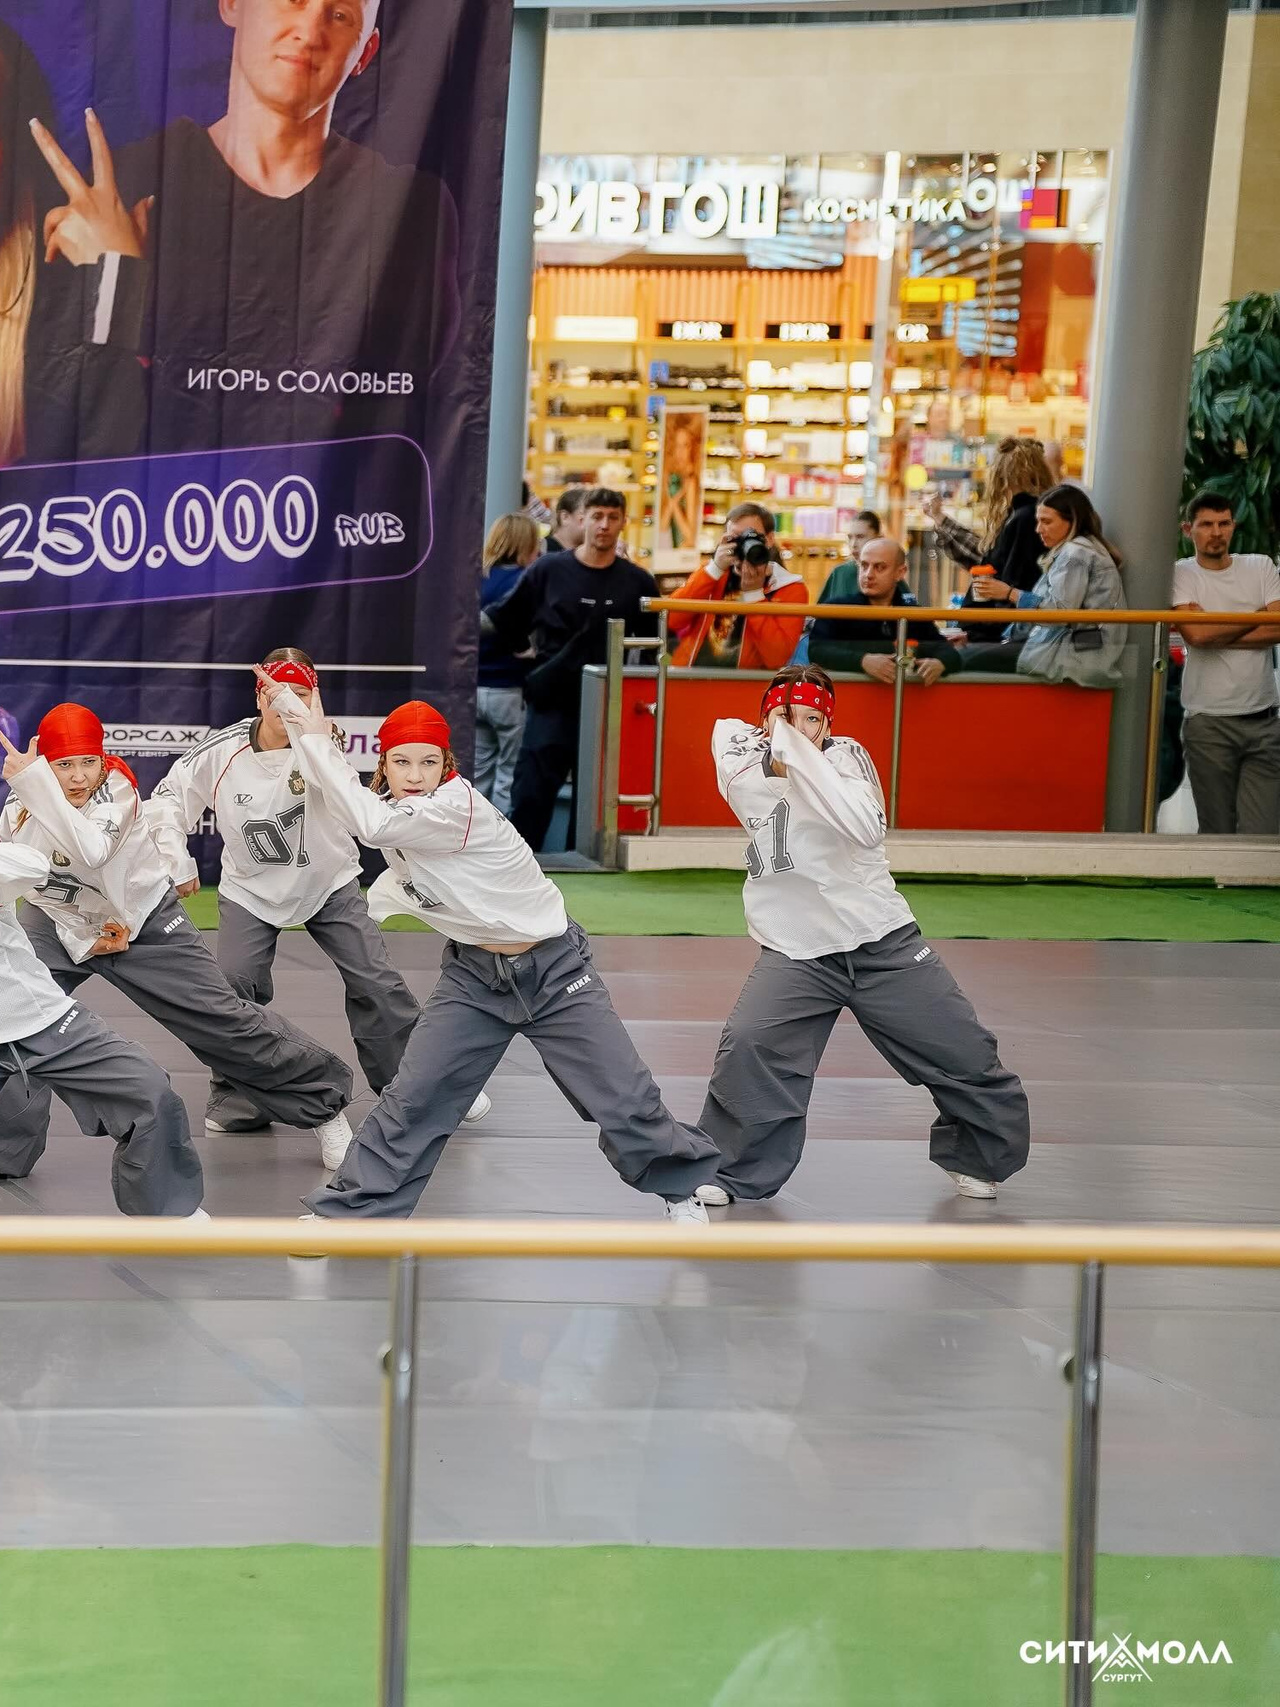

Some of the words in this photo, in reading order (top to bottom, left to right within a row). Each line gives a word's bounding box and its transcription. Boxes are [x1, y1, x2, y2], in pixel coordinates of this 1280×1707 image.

[803, 197, 967, 223] КОСМЕТИКА
[187, 368, 270, 392] ИГОРЬ
[277, 370, 415, 395] СОЛОВЬЕВ
[334, 512, 405, 547] RUB
